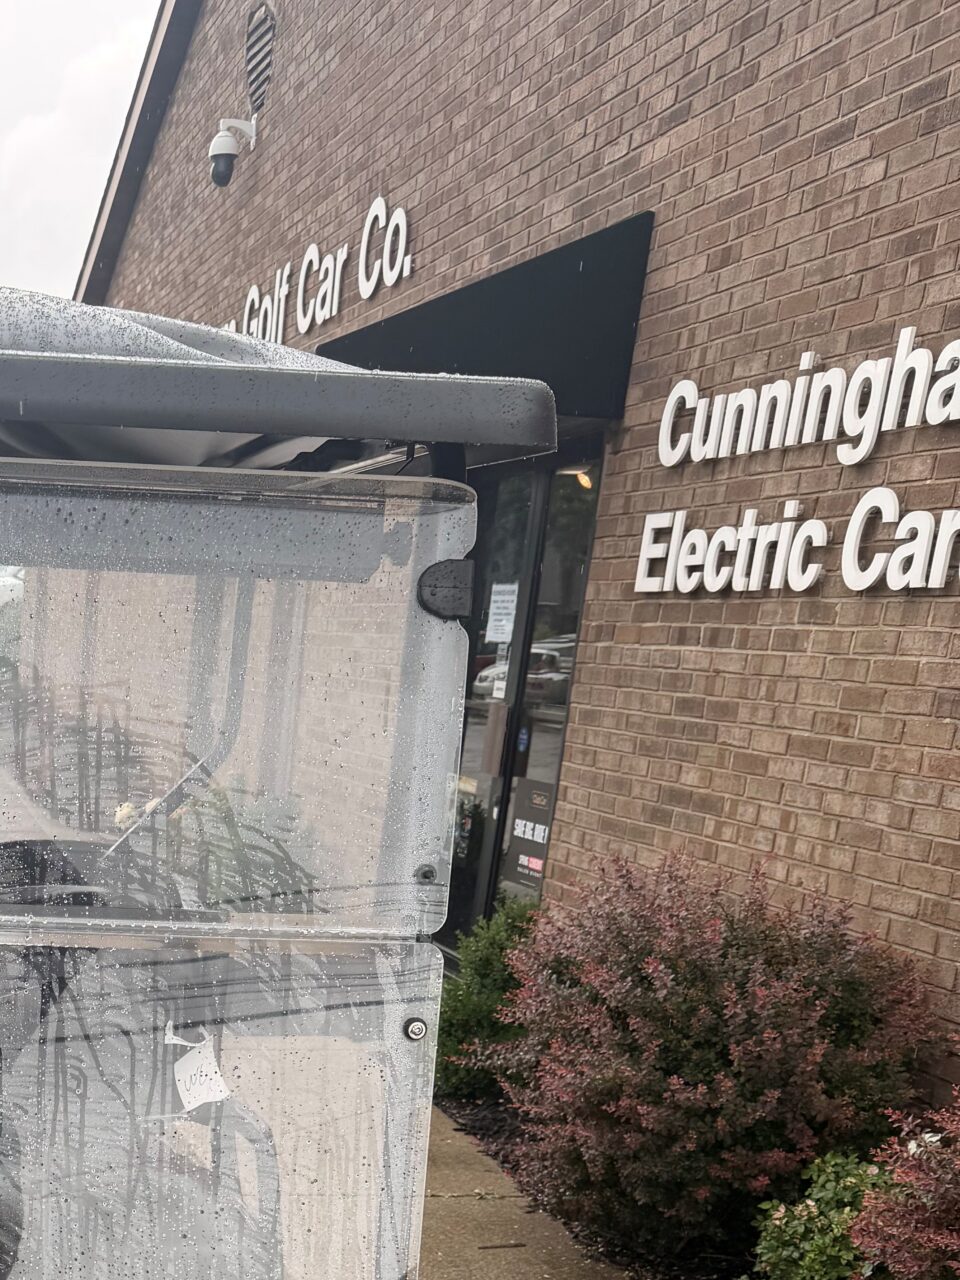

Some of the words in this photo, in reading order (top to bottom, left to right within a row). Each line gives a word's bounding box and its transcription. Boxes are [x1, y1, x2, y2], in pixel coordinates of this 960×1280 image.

[243, 261, 291, 344] Golf
[297, 243, 349, 334] Car
[359, 196, 413, 300] Co.
[658, 326, 960, 467] Cunningha
[634, 500, 828, 594] Electric
